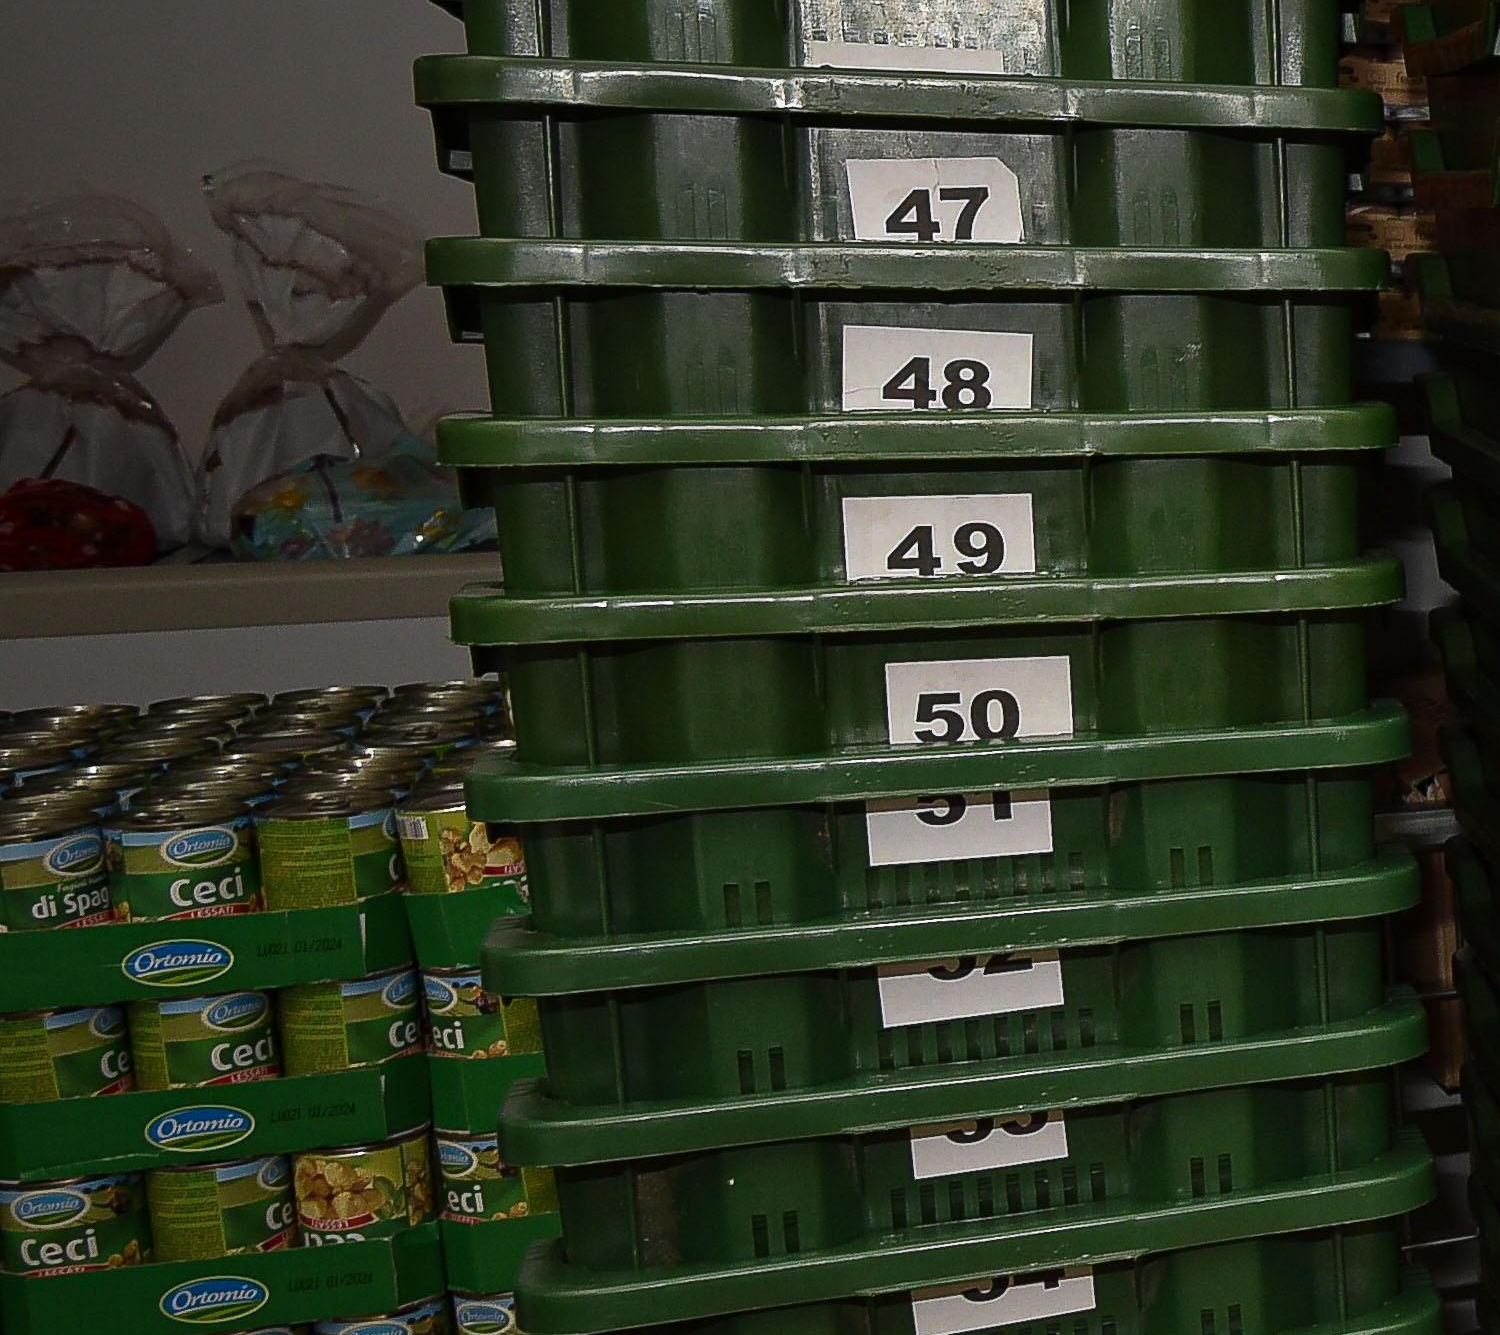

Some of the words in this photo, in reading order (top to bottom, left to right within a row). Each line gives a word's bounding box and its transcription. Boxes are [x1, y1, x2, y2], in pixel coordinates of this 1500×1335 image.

[884, 186, 989, 242] 47
[882, 357, 992, 410] 48
[886, 521, 1005, 577] 49
[914, 689, 1021, 744] 50
[31, 898, 57, 921] di
[62, 887, 111, 915] Spag
[169, 867, 245, 907] Ceci
[134, 946, 223, 973] Ortomio
[210, 1030, 274, 1072] Ceci
[155, 1112, 244, 1138] Ortomio
[20, 1228, 99, 1266] Ceci
[170, 1282, 260, 1309] Ortomio
